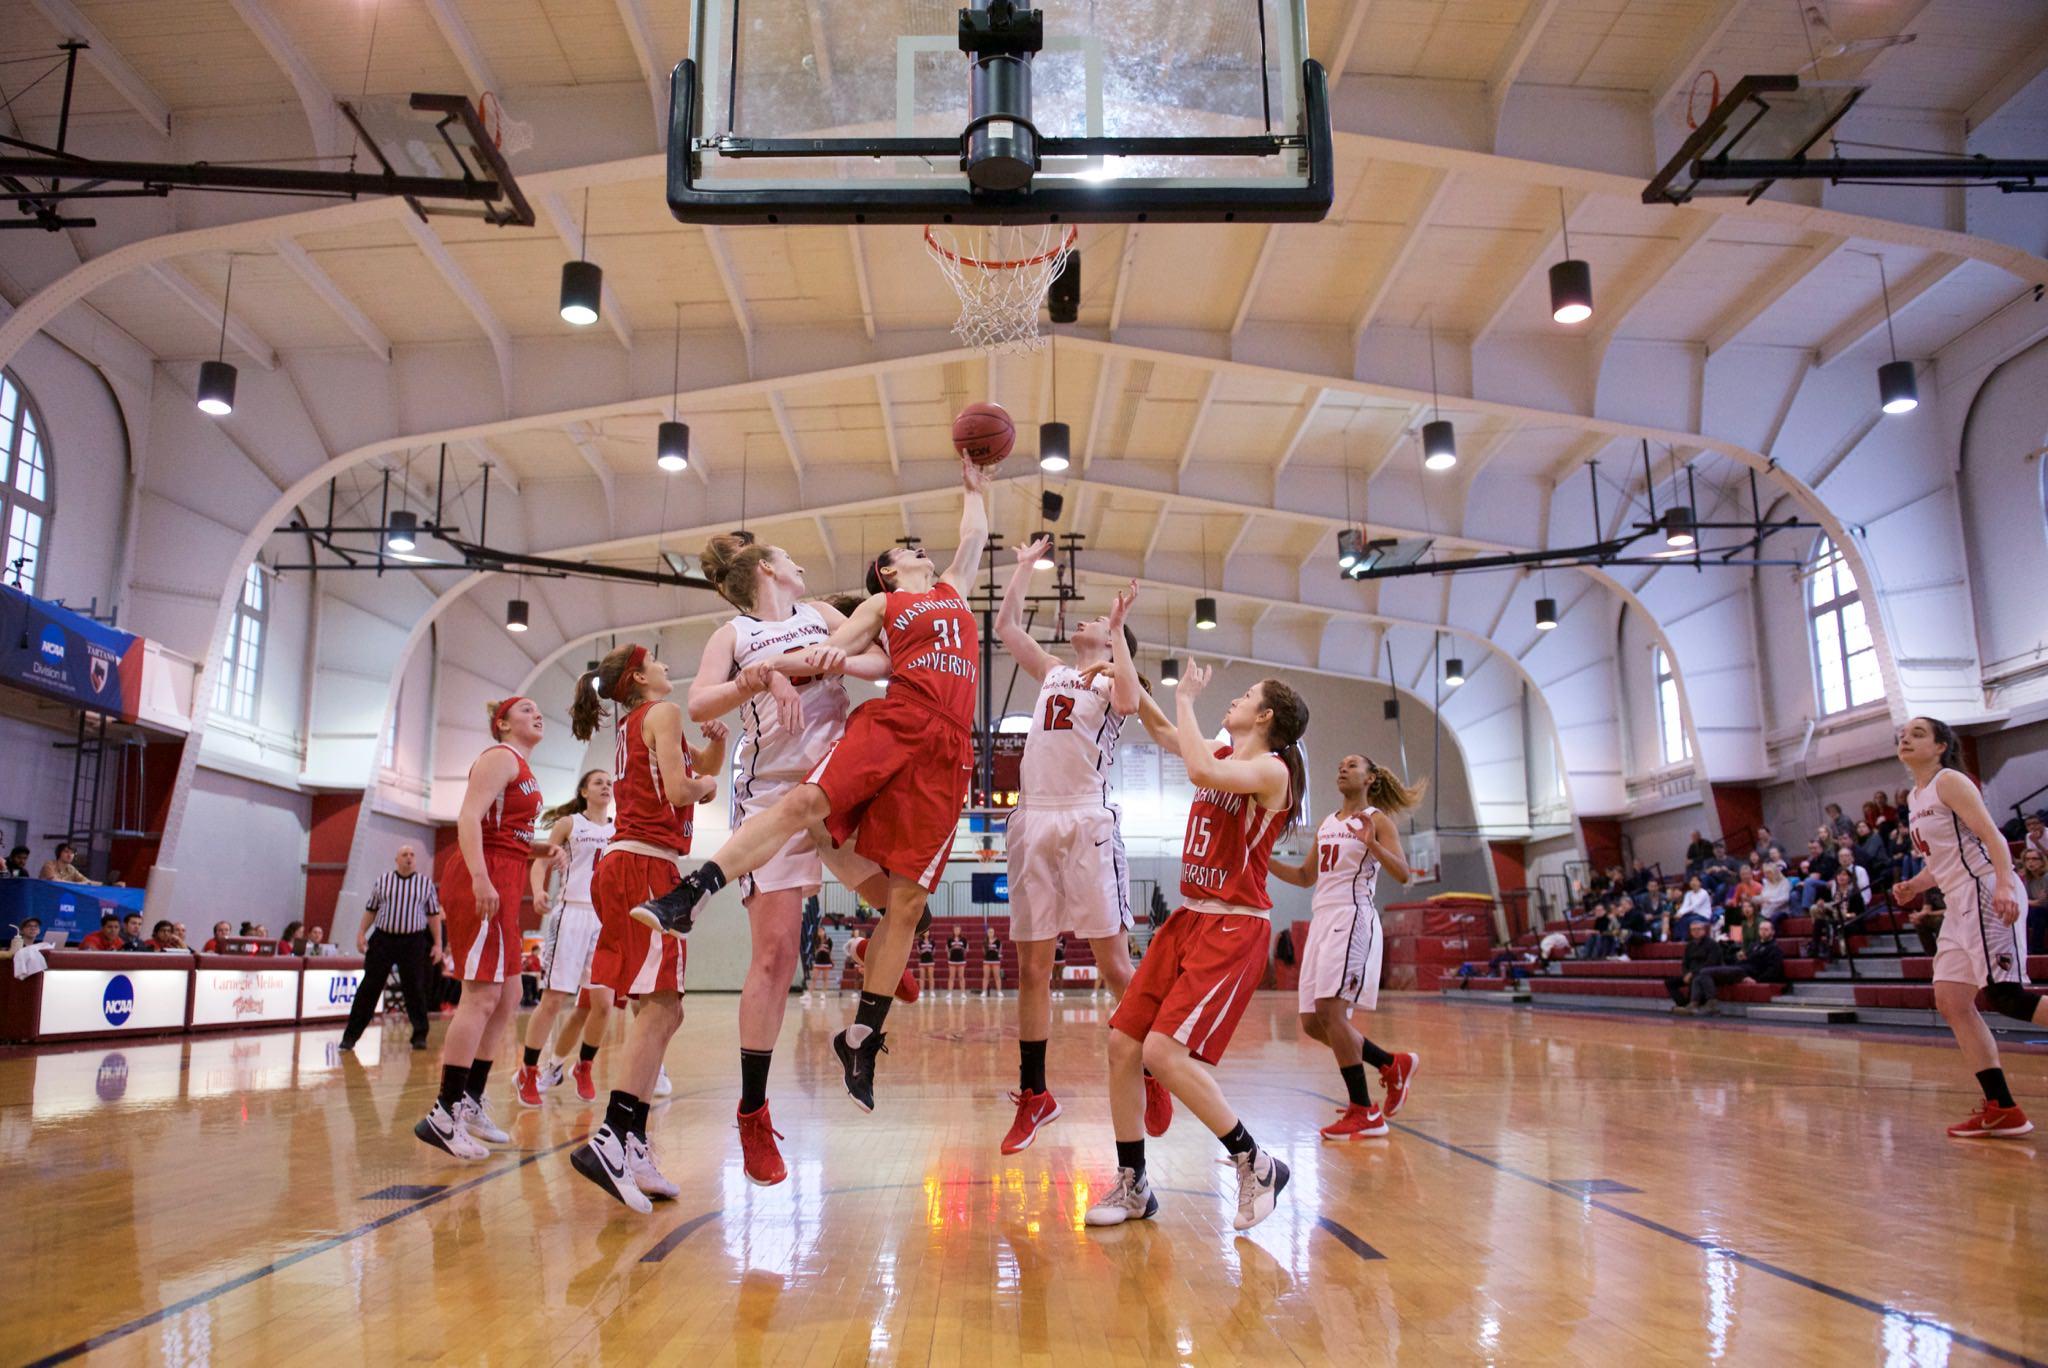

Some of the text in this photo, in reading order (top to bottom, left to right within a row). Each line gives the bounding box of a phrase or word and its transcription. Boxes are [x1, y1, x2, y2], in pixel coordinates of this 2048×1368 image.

[893, 598, 974, 631] WASHINGTO
[751, 632, 798, 651] Carnegie
[932, 618, 961, 651] 31
[42, 641, 64, 658] NCAA
[33, 662, 60, 680] Division
[907, 652, 976, 683] UNIVERSITY
[1044, 694, 1075, 731] 12
[1185, 815, 1212, 858] 15
[1320, 844, 1340, 872] 21
[212, 974, 284, 992] Carnegie Mellon
[105, 1000, 133, 1014] NCAA
